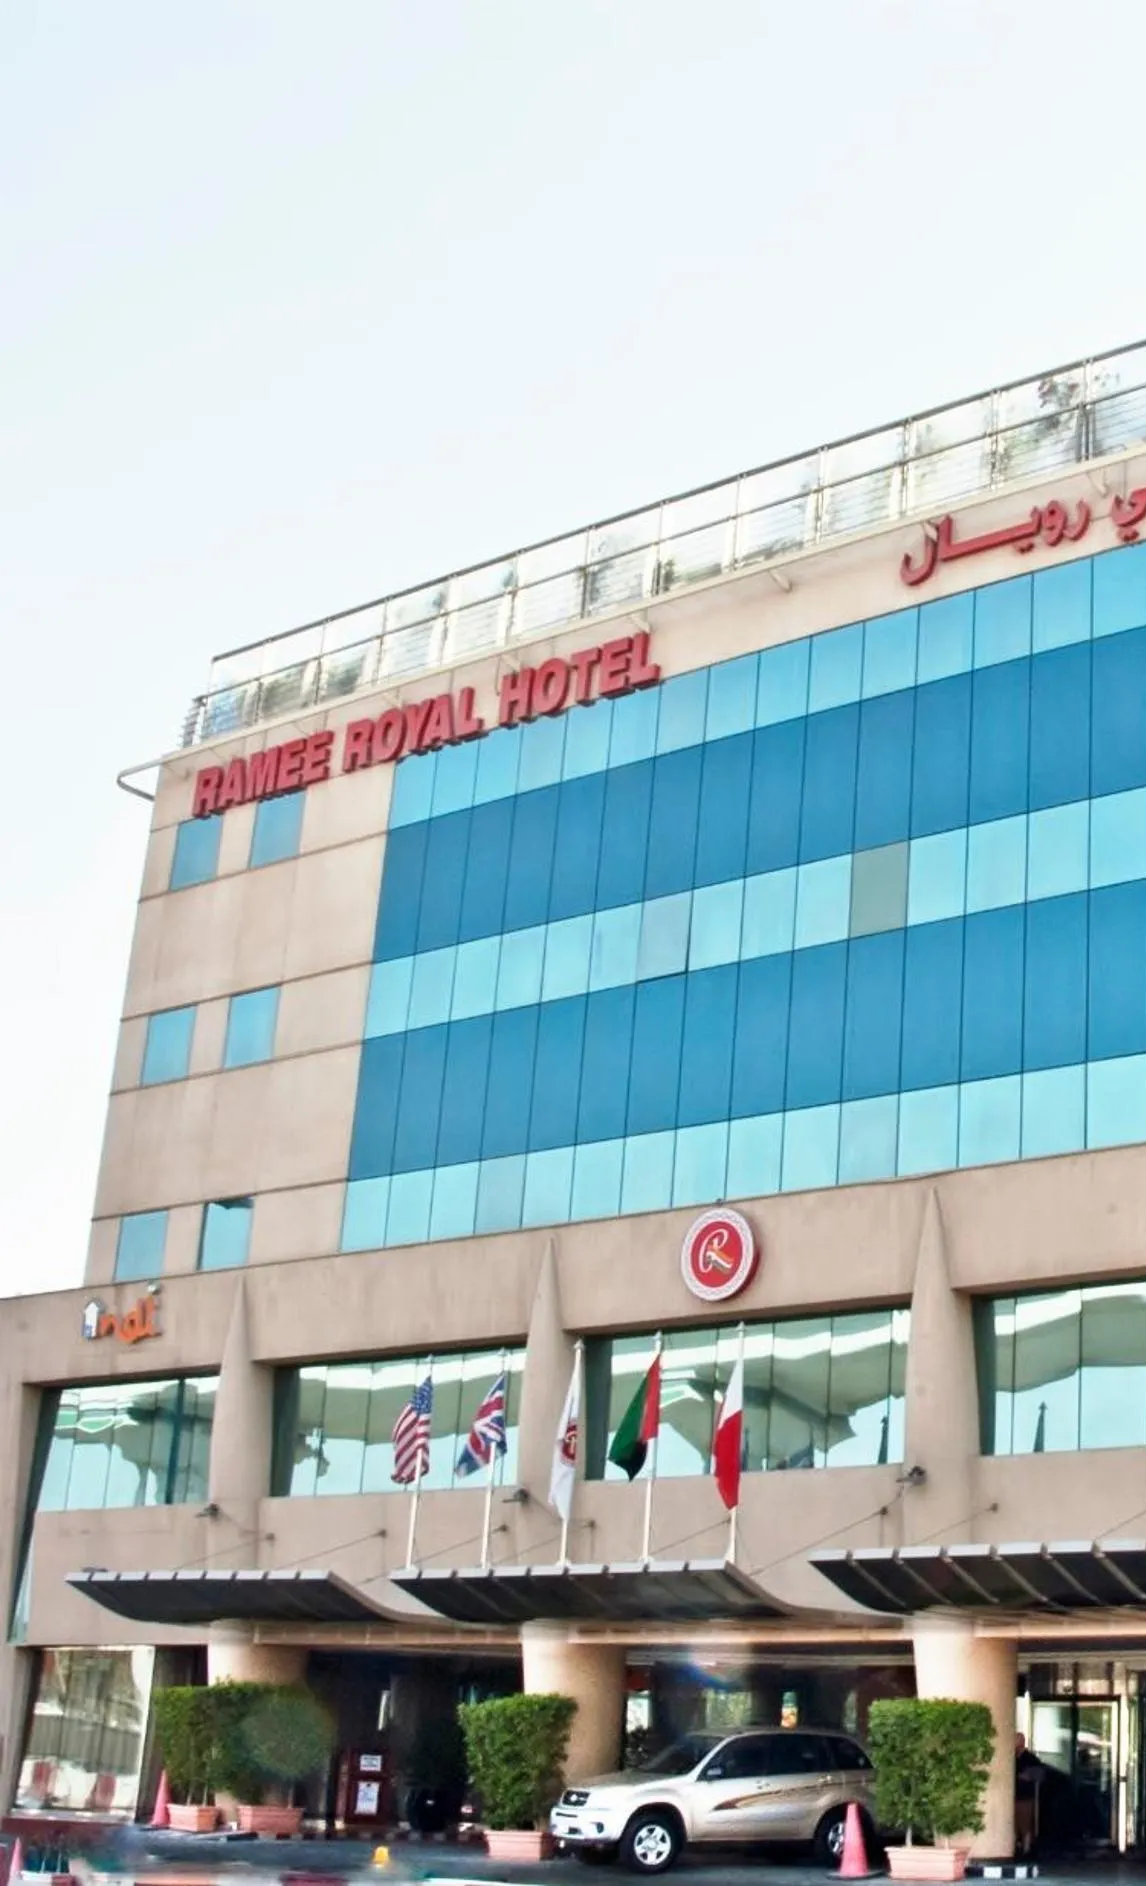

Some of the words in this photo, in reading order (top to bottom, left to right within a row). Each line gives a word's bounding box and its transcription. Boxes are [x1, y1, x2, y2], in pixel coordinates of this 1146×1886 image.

[901, 513, 1090, 585] رويال
[194, 731, 335, 818] RAMEE
[343, 687, 485, 772] ROYAL
[499, 632, 661, 729] HOTEL
